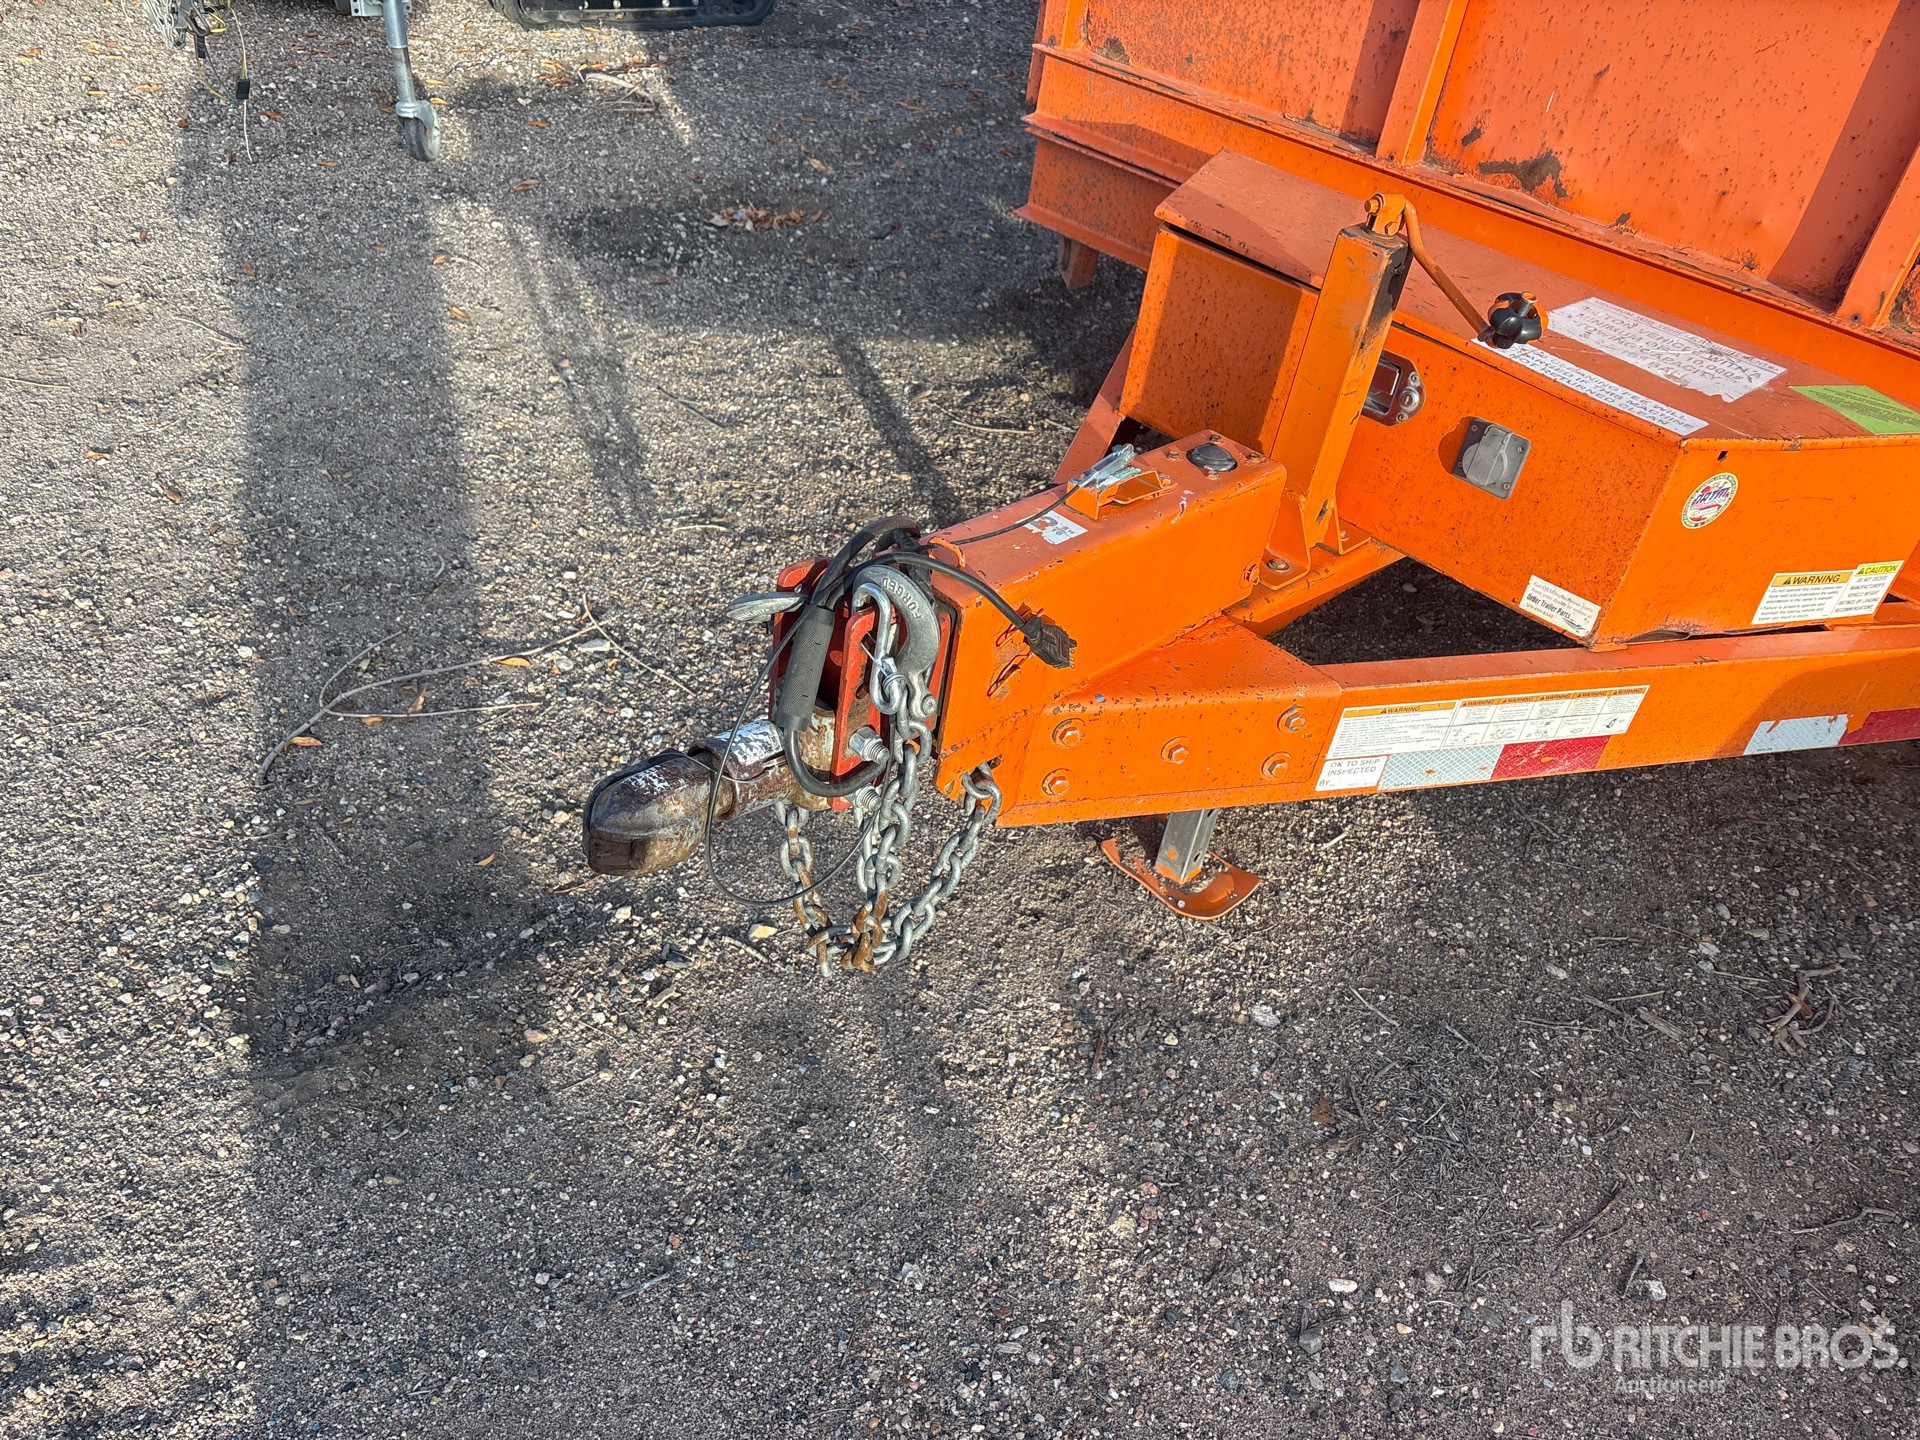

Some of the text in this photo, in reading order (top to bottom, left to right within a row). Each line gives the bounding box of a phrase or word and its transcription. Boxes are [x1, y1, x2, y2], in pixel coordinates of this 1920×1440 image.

[1573, 313, 1644, 341] MINIMUM
[1599, 313, 1636, 329] TON
[1636, 327, 1704, 355] VEHICLE
[1705, 354, 1750, 373] WITH
[1574, 321, 1638, 348] TOWING
[1638, 347, 1720, 380] CAPACITY
[1507, 353, 1539, 367] NOT
[1537, 367, 1617, 403] RETURNED
[1617, 402, 1669, 425] CLEAN
[1548, 358, 1621, 391] CLEANING
[1651, 404, 1689, 421] WILL
[1591, 384, 1625, 399] THIS
[1625, 398, 1694, 429] MACHINE
[1791, 574, 1841, 584] WARNING
[1864, 565, 1897, 574] CAUTION
[882, 576, 923, 620] FORGED
[1526, 592, 1571, 619] Order Trailer Parts
[1326, 765, 1377, 776] INSPECTED
[1359, 757, 1380, 765] SHIP
